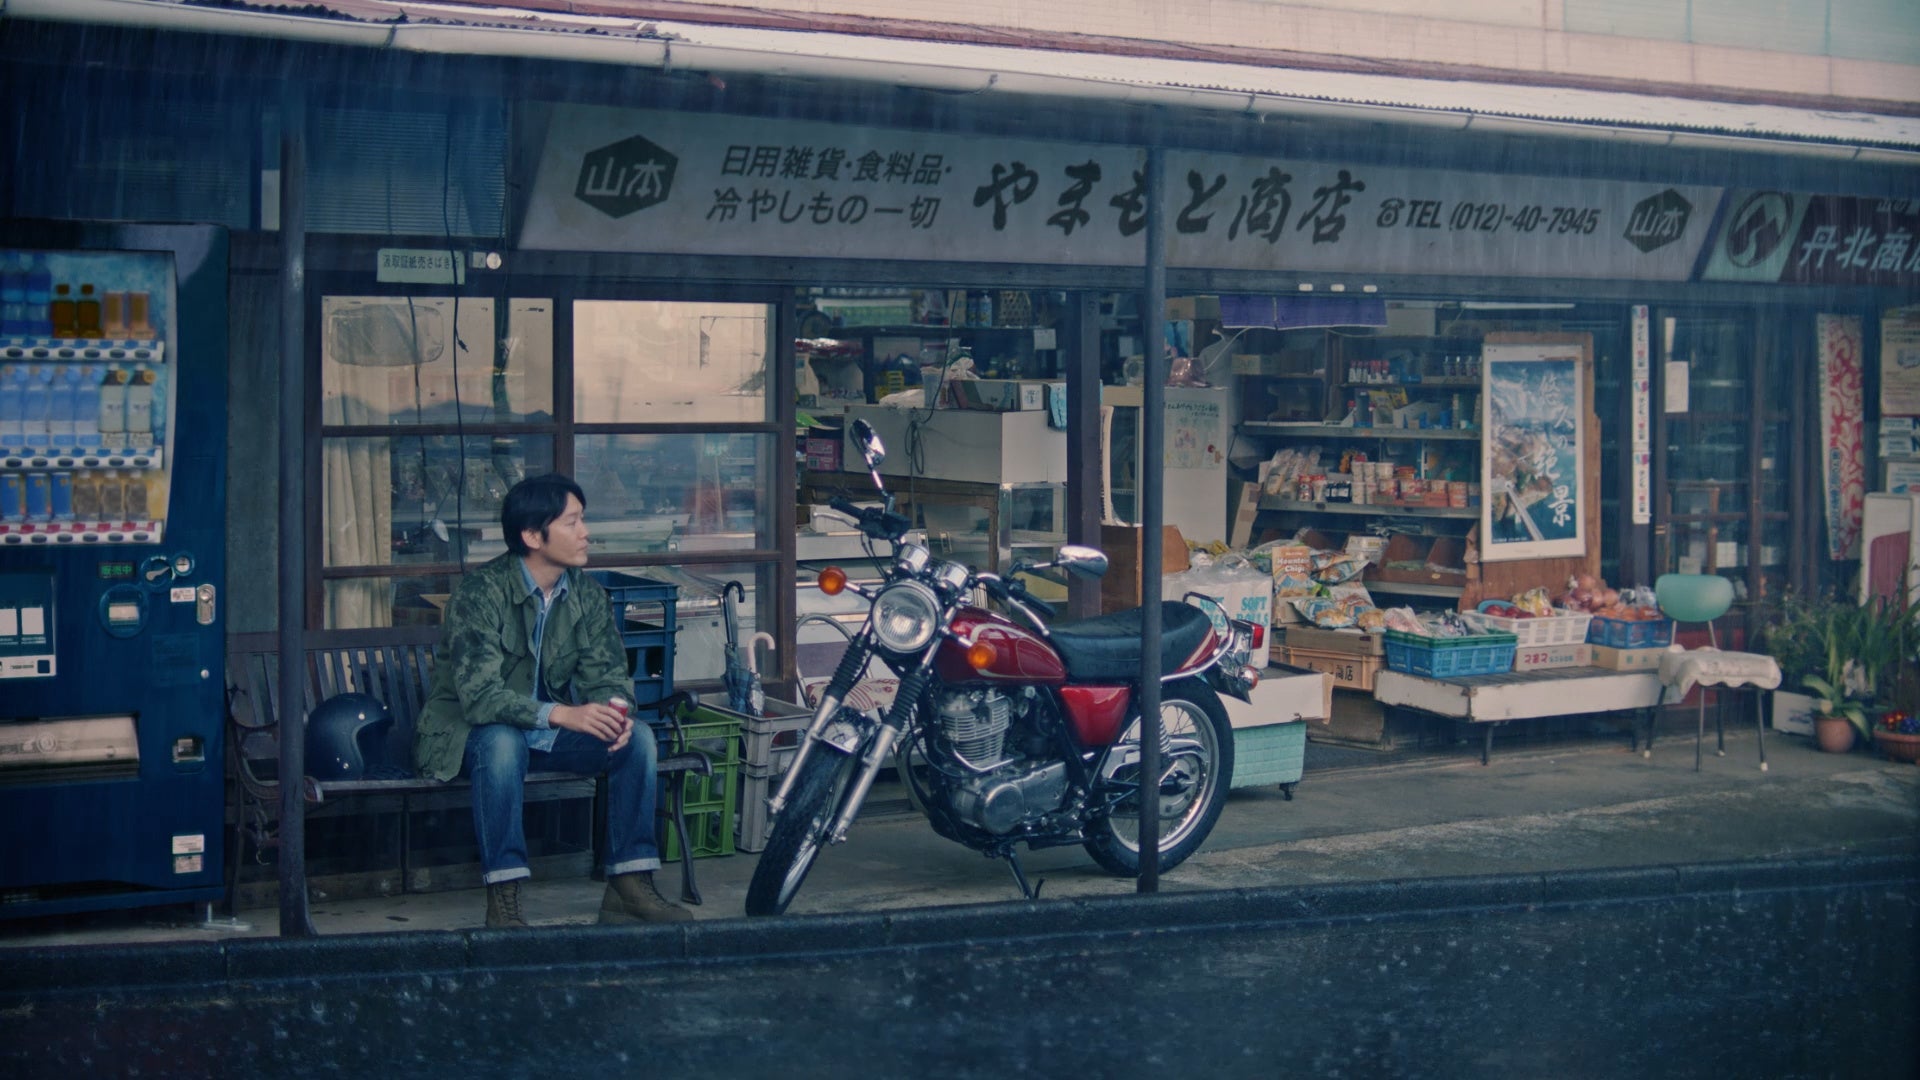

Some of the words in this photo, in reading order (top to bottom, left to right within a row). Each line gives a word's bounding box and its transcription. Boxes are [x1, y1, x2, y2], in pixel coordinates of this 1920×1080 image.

[584, 157, 666, 198] 山本
[705, 187, 940, 229] 冷やしもの一切
[972, 157, 1366, 245] やまもと商店
[1406, 198, 1441, 229] TEL
[1449, 202, 1601, 235] (012)-40-7945
[1630, 205, 1682, 239] 山本
[1241, 596, 1268, 611] SOFT
